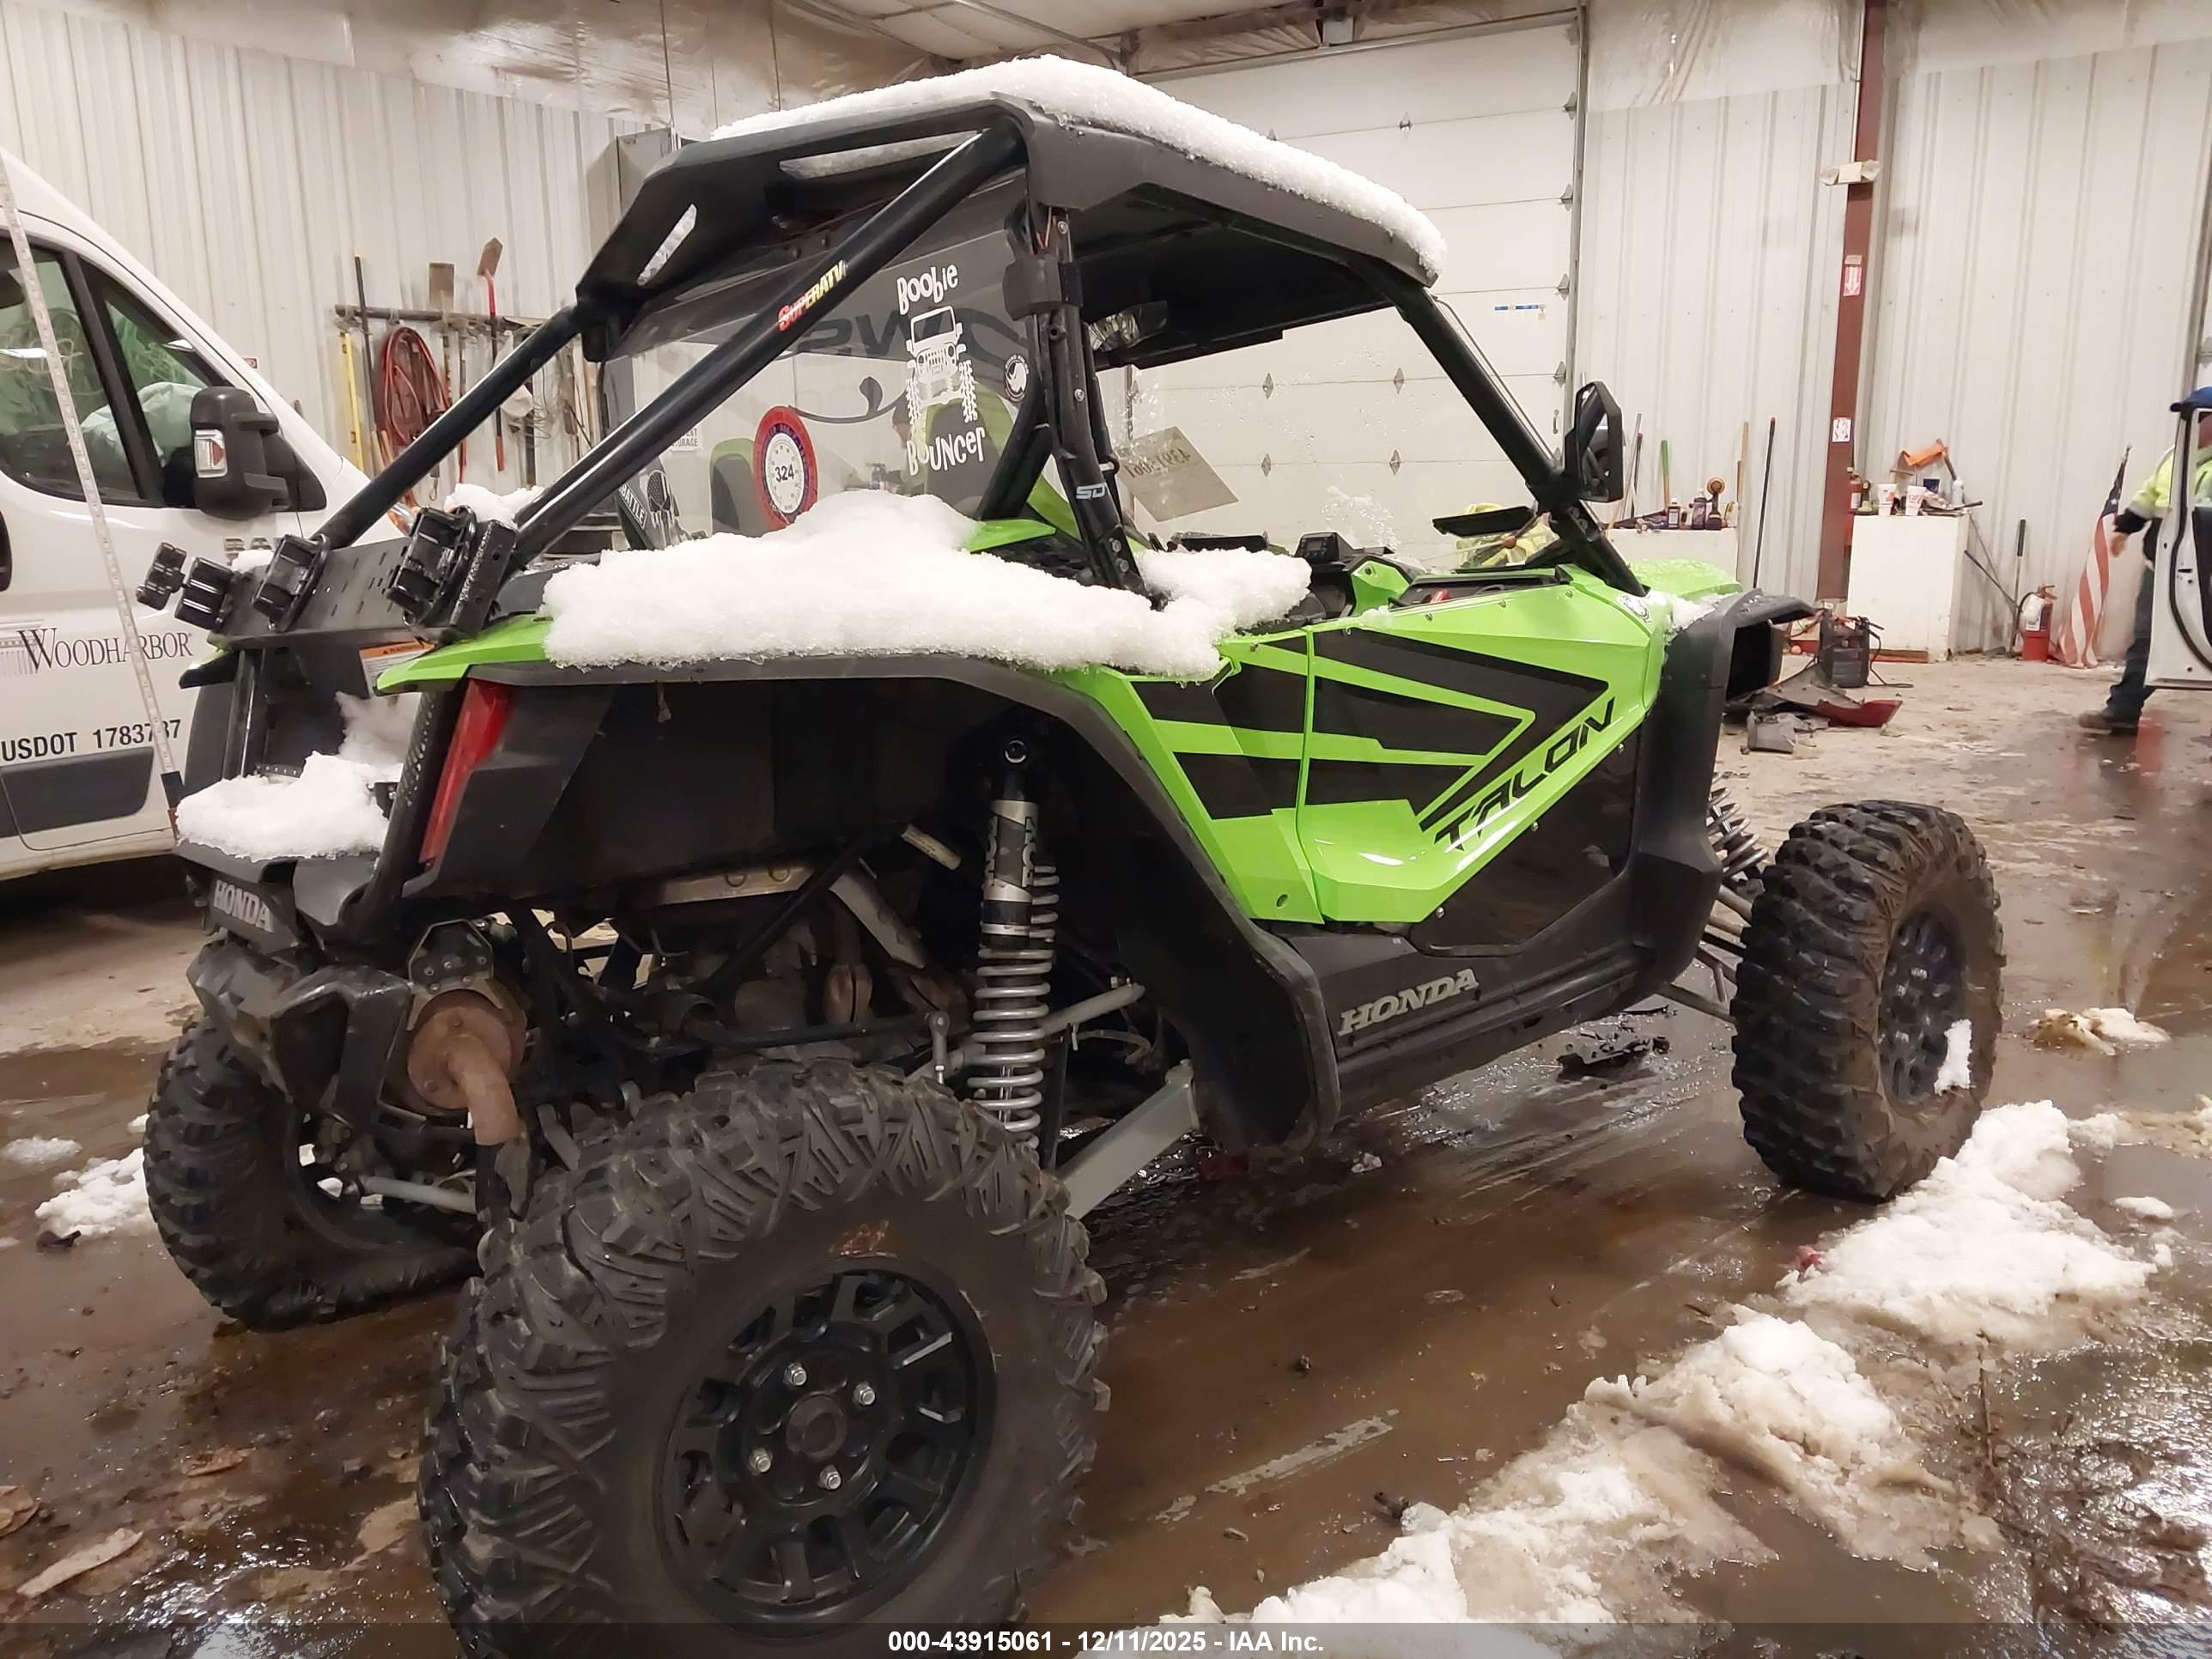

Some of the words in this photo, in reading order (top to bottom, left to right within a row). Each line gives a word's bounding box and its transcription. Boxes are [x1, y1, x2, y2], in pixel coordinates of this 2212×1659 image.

[775, 464, 794, 483] 324
[1, 732, 78, 762] USDOT
[1434, 696, 1615, 852] TALON
[213, 879, 274, 933] HONDA
[1338, 968, 1479, 1036] HONDA
